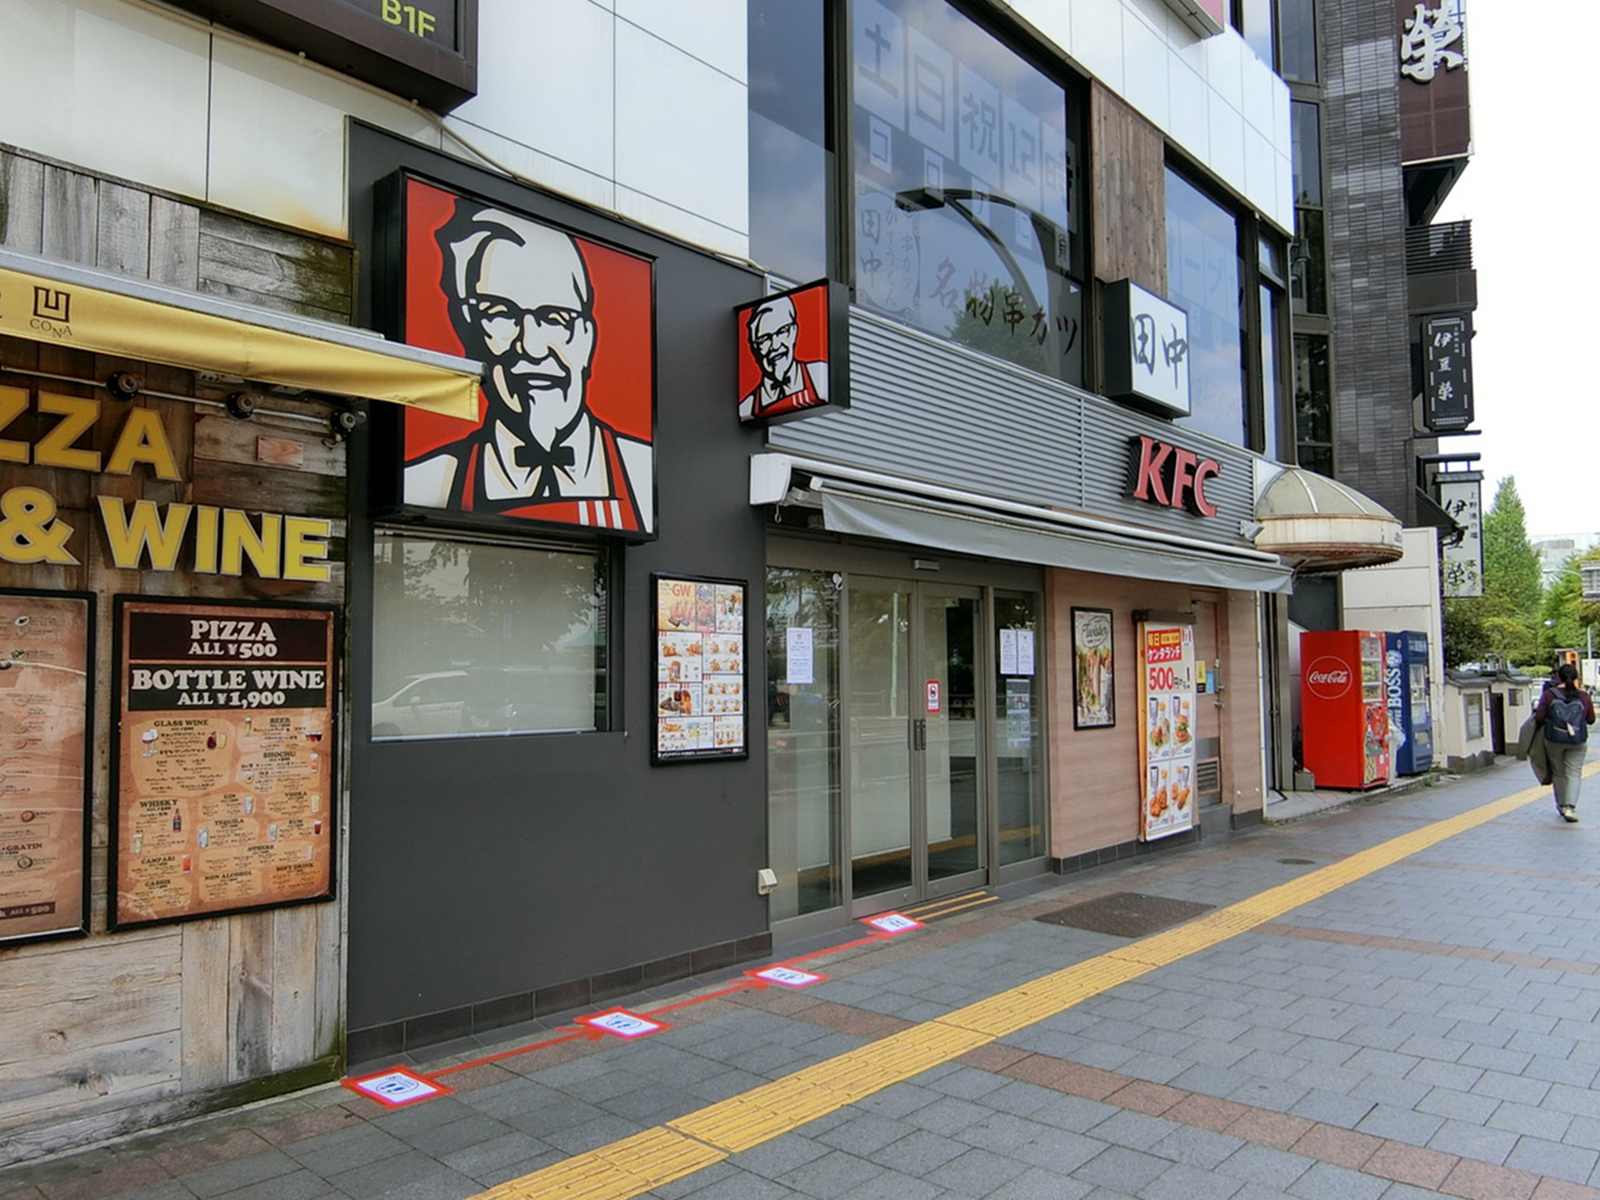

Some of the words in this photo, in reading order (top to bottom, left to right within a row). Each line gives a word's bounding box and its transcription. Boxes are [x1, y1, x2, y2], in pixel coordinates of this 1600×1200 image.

[382, 0, 436, 38] B1F
[30, 318, 73, 338] CONA
[1131, 435, 1220, 518] KFC
[0, 487, 81, 566] &
[98, 495, 332, 582] WINE
[672, 583, 691, 598] GW
[190, 619, 277, 641] PIZZA
[188, 642, 225, 655] ALL
[228, 643, 278, 659] ¥500
[131, 669, 247, 690] BOTTLE
[252, 670, 325, 689] WINE
[1386, 668, 1402, 708] BOSS
[177, 692, 214, 705] ALL
[218, 691, 286, 709] ¥1,900
[140, 798, 178, 808] WHISKY
